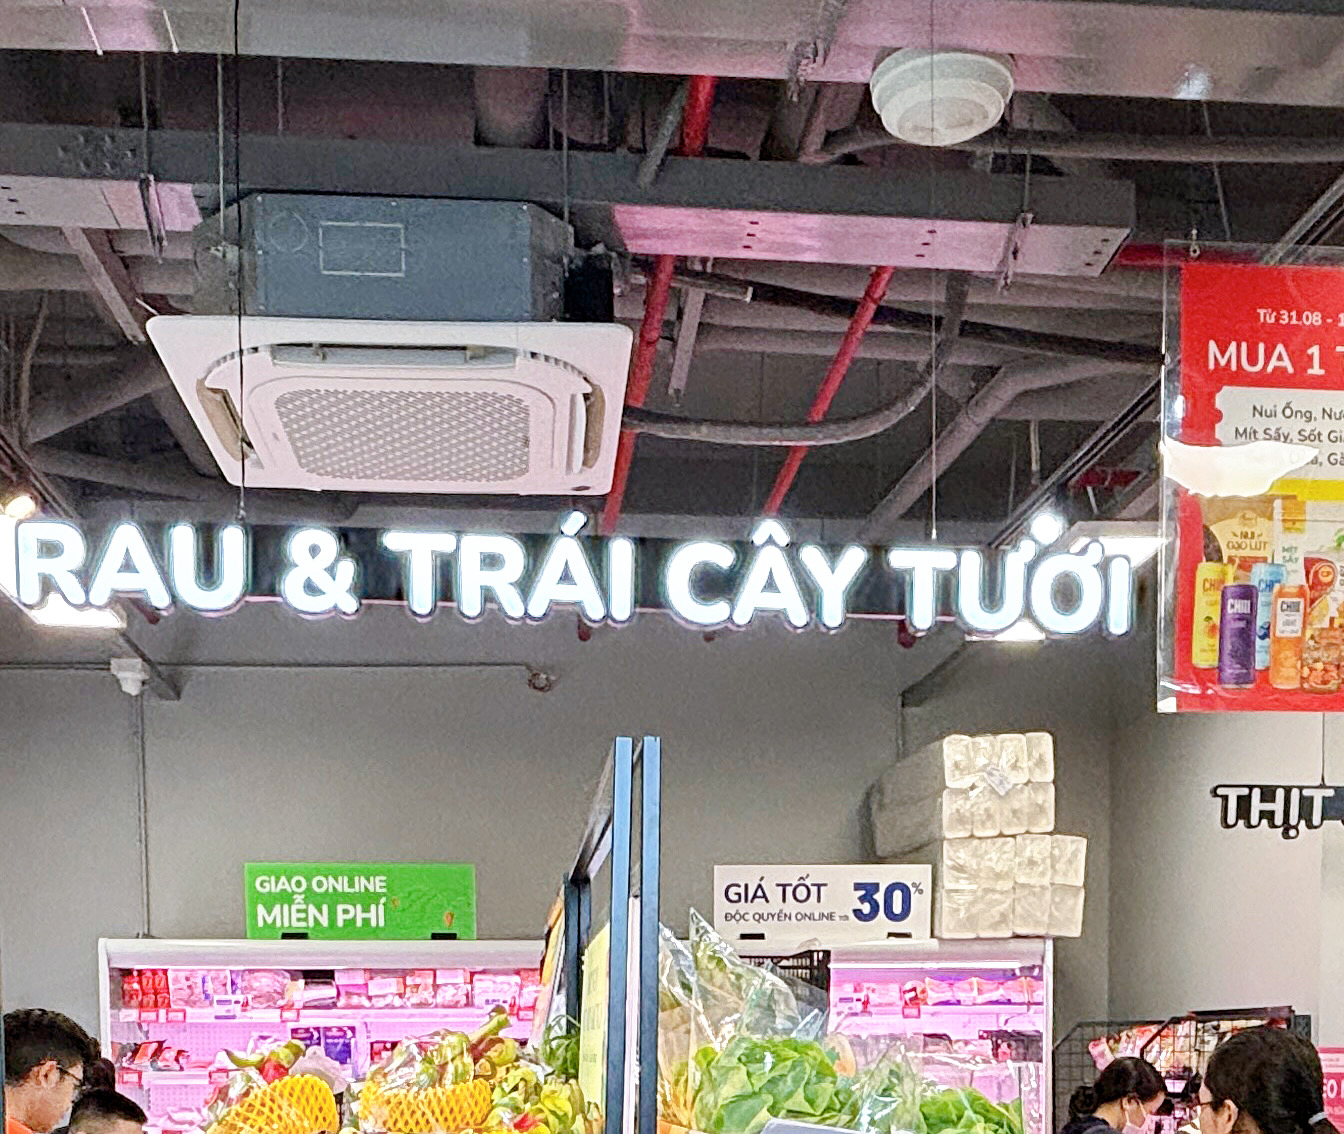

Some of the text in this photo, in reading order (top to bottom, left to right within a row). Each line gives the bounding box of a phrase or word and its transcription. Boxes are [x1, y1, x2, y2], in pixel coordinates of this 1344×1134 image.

[1257, 308, 1276, 324] Từ
[1280, 309, 1322, 326] 31.08
[1208, 339, 1294, 374] MUA
[1307, 345, 1325, 375] 1
[1252, 404, 1277, 418] Nui
[1282, 401, 1317, 423] Ống,
[1234, 427, 1257, 440] Mít
[1263, 427, 1293, 442] Sấy,
[1297, 427, 1323, 442] Sốt
[13, 520, 249, 615] RAU
[281, 527, 360, 617] &
[381, 509, 636, 625] TRÁI
[666, 520, 866, 630] CÂY
[1214, 787, 1336, 841] THỊT
[255, 875, 387, 893] GIAO ONLINE
[724, 876, 770, 904] GIÁ
[776, 873, 828, 904] TỐT
[257, 894, 386, 928] MIỄN PHÍ
[724, 909, 836, 924] ĐỘC QUYỀN ONLINE
